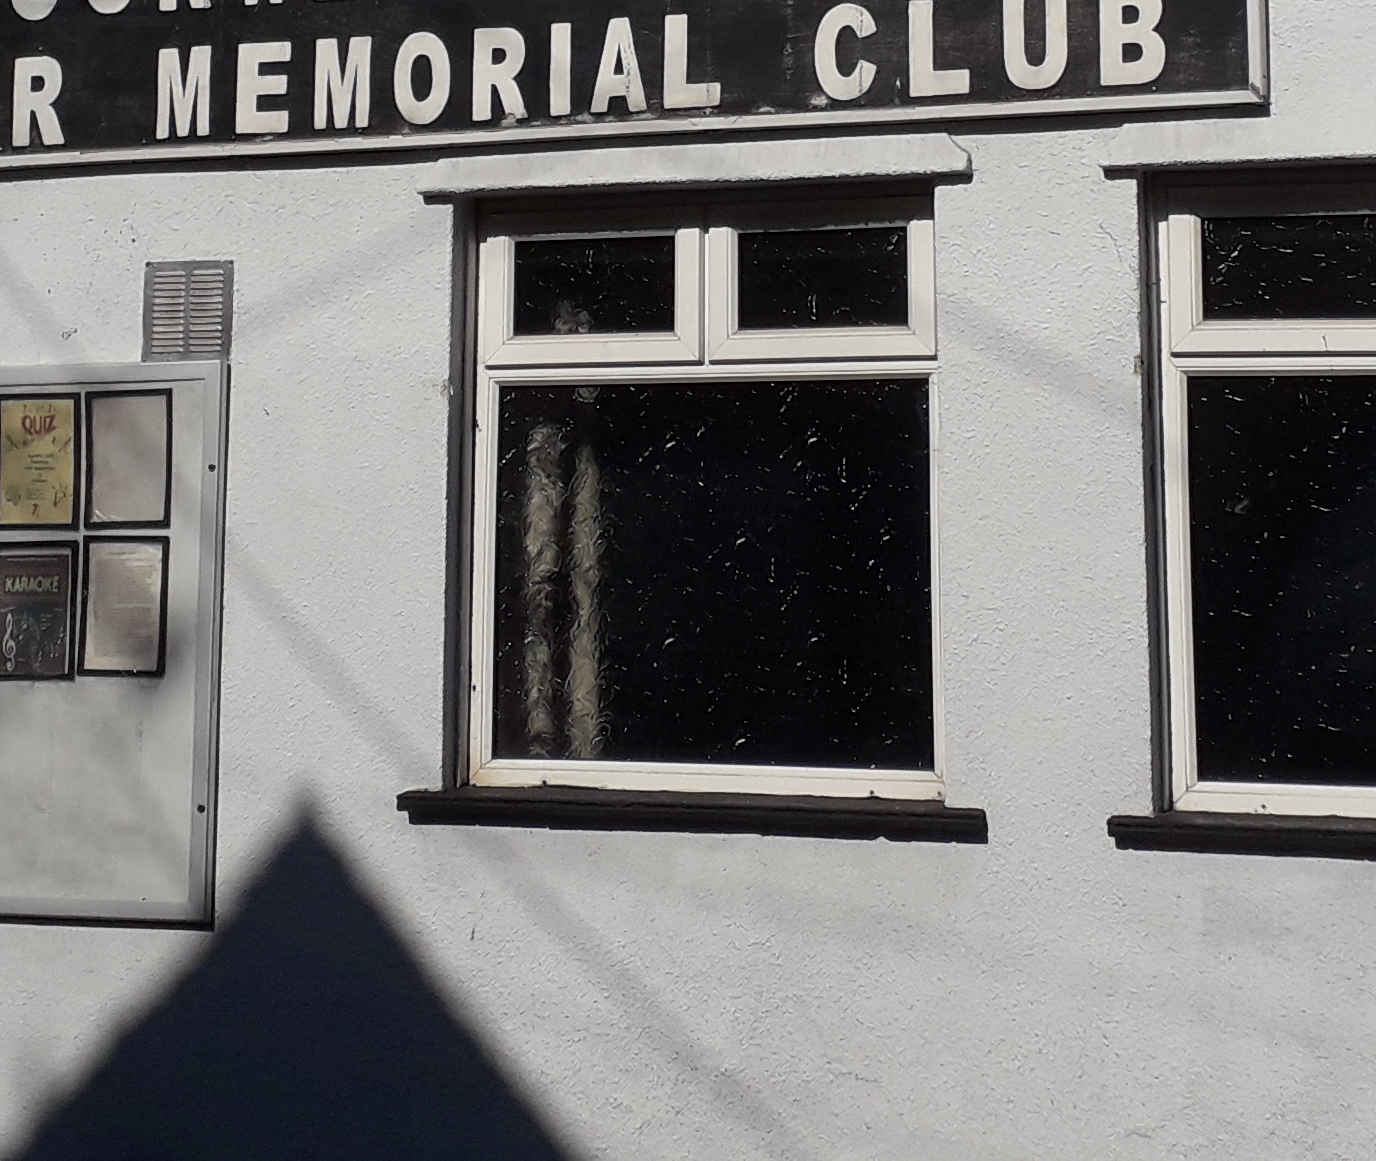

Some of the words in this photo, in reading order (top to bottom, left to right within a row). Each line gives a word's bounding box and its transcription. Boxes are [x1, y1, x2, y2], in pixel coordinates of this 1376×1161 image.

[155, 13, 722, 140] MEMORIAL
[21, 413, 58, 436] QUIZ
[5, 575, 60, 594] KARAOKE
